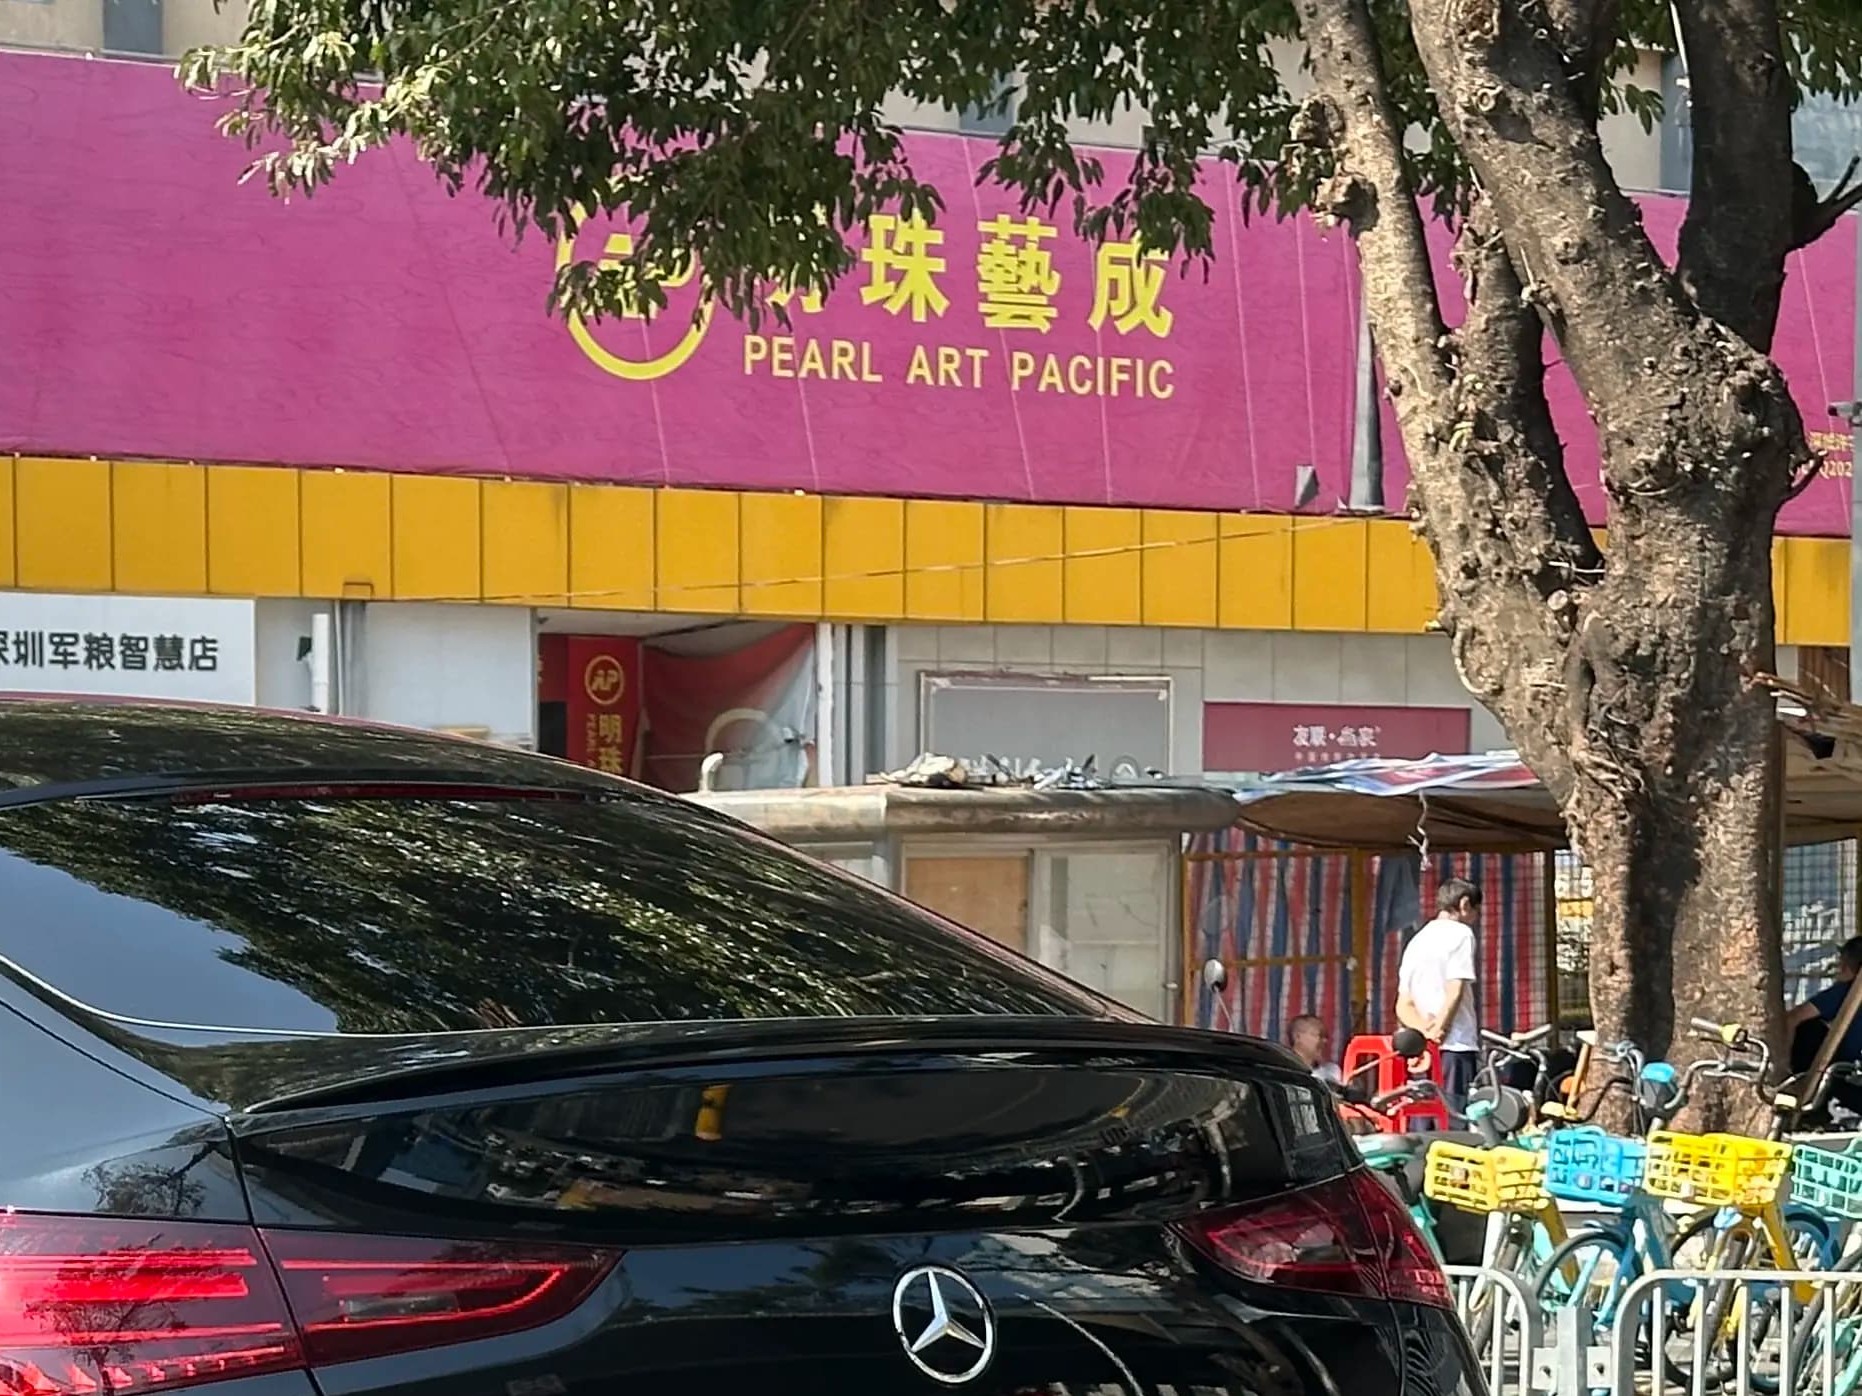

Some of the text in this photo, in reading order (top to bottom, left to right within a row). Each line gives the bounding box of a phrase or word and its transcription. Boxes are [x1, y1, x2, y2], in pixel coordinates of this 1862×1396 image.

[766, 211, 1174, 338] 珠藝成
[743, 335, 1174, 399] PEARL ART PACIFIC
